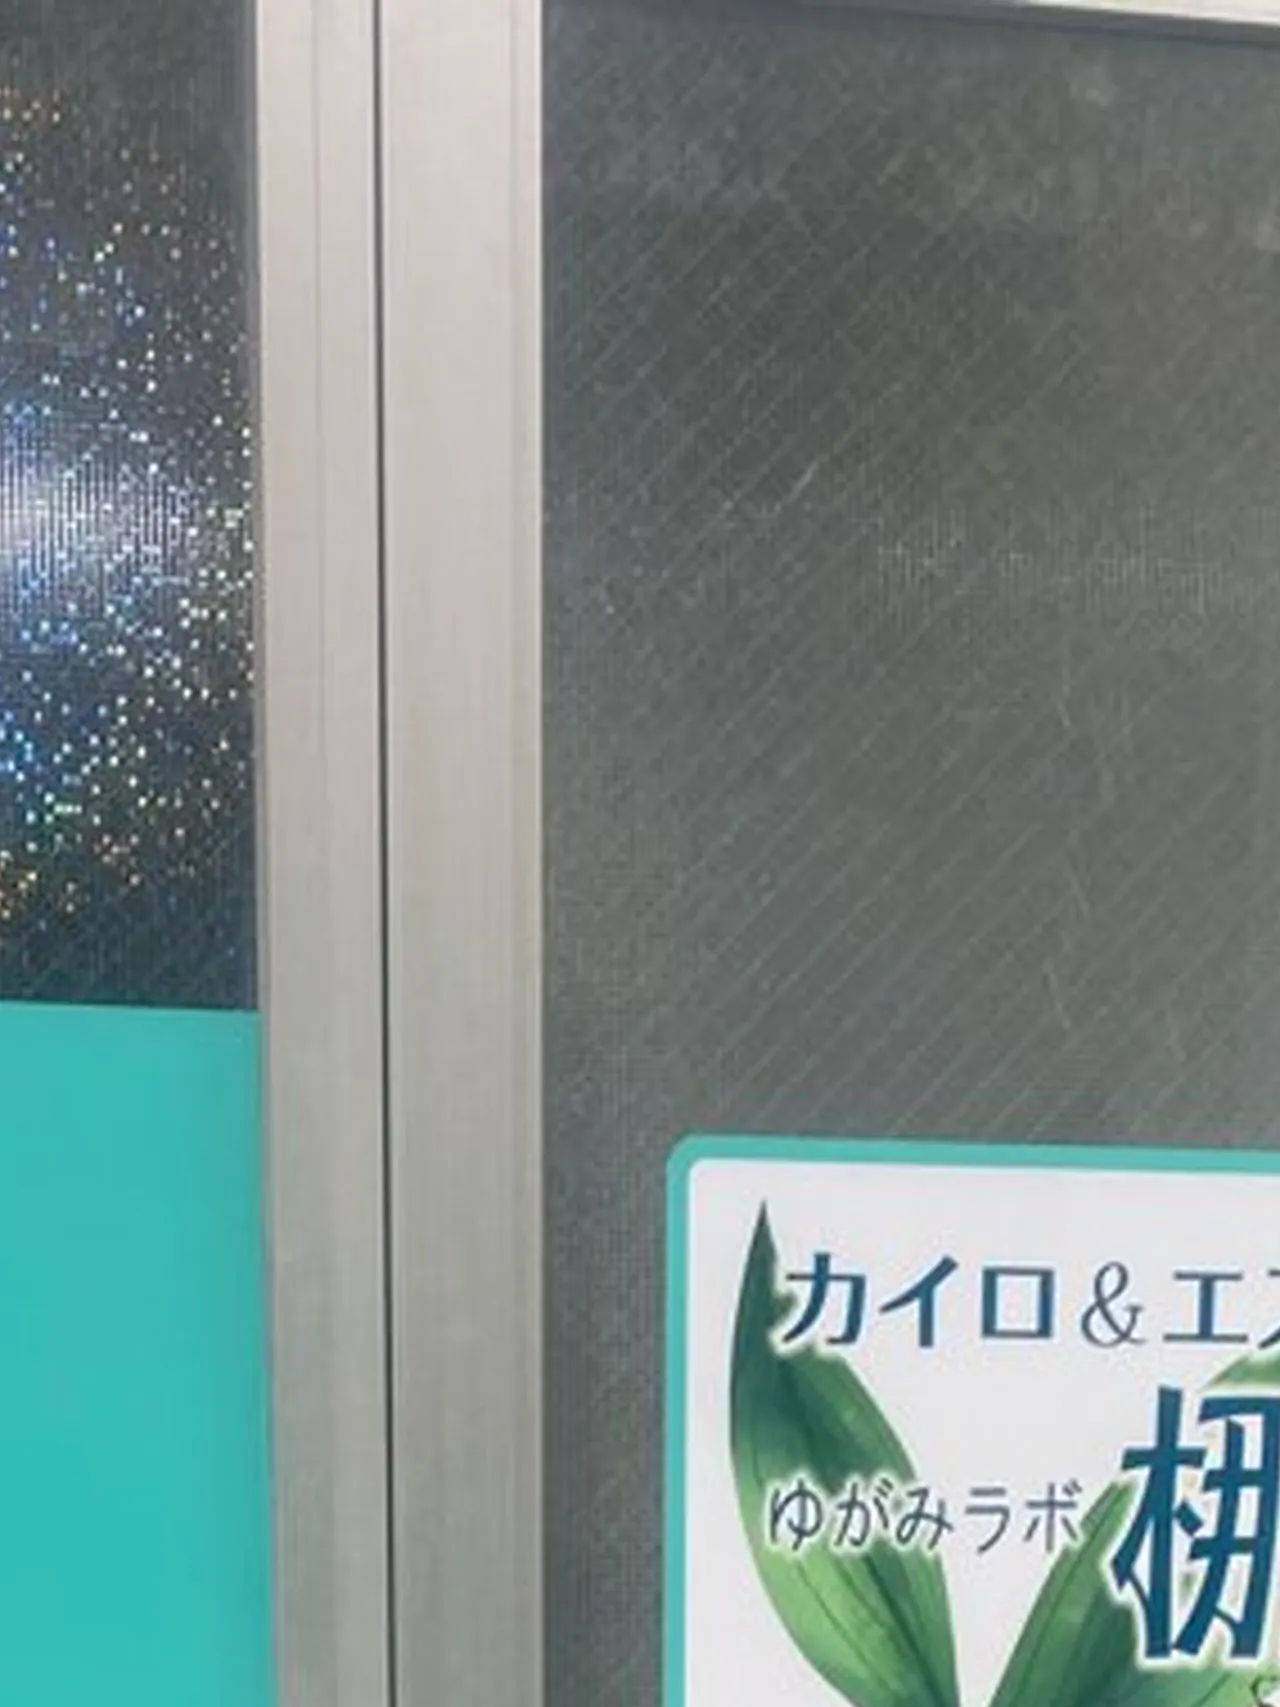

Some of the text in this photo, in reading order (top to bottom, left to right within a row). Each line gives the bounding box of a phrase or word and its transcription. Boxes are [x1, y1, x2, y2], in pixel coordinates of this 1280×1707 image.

[766, 1476, 1082, 1556] ゆがみラボ
